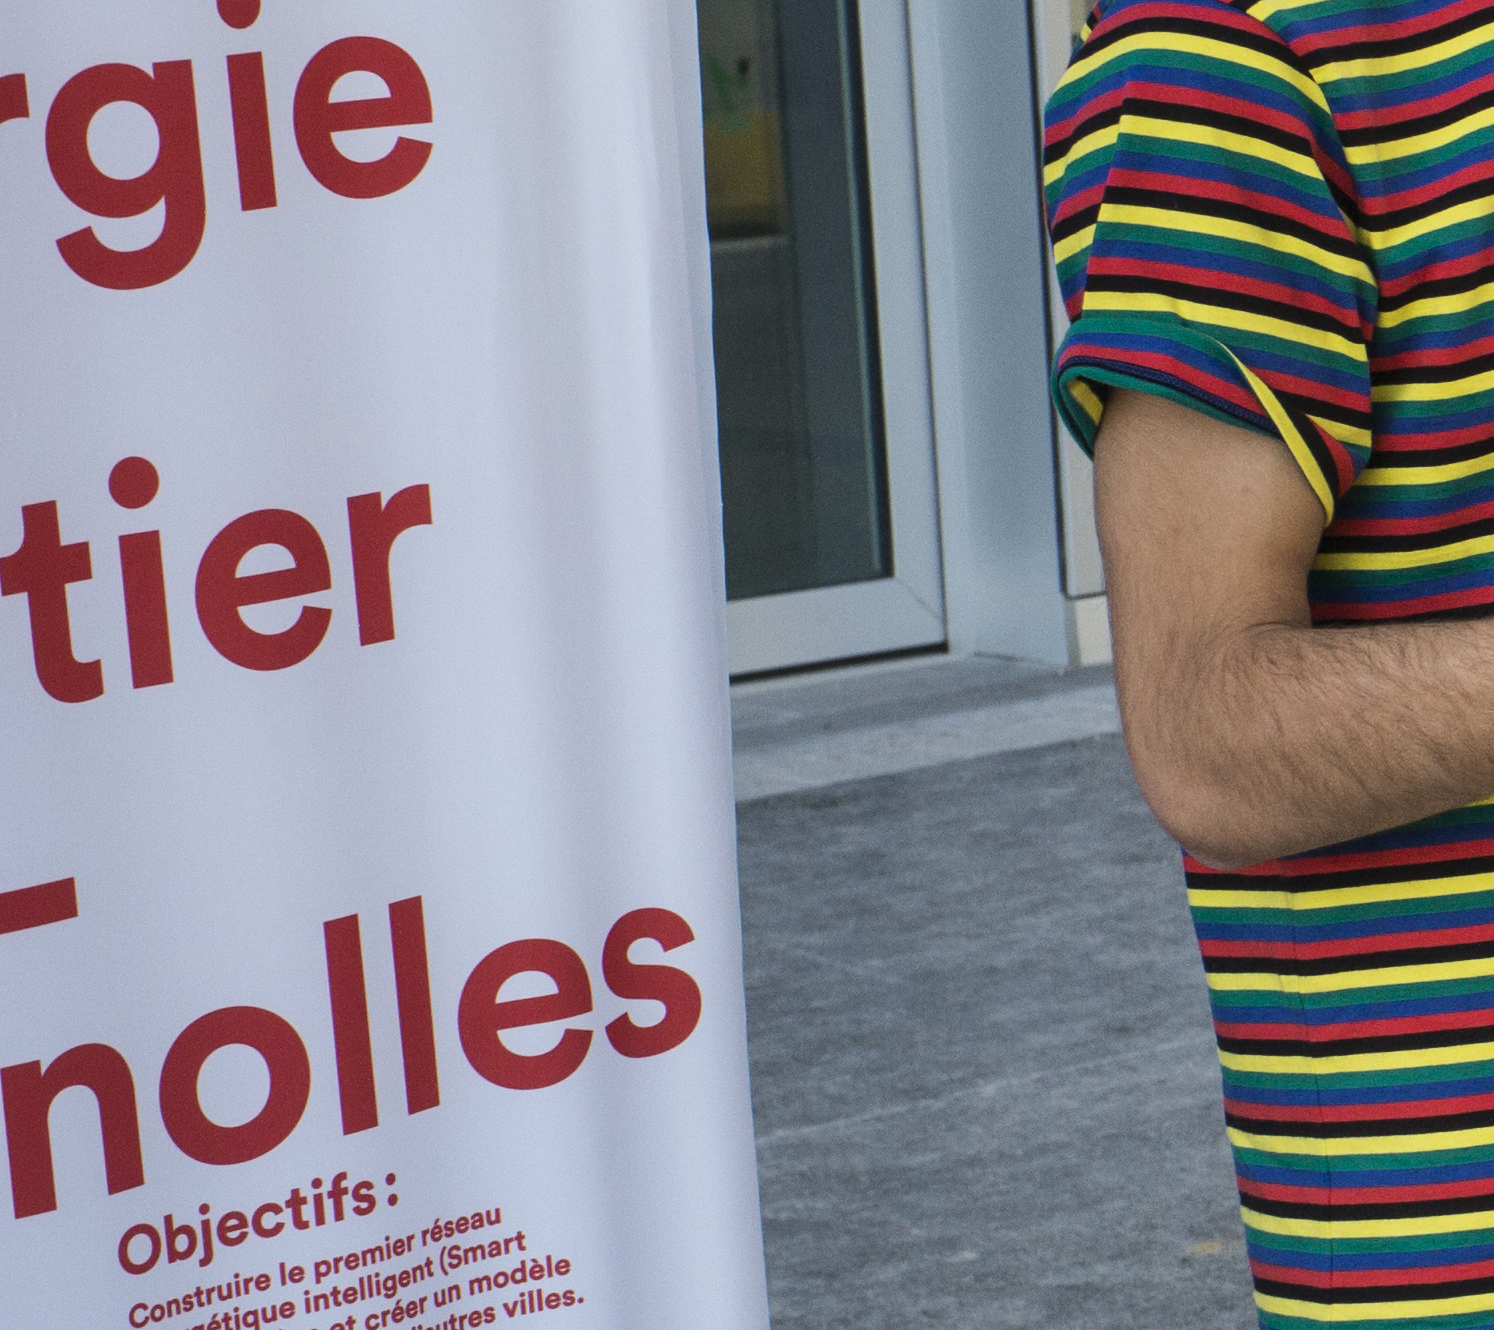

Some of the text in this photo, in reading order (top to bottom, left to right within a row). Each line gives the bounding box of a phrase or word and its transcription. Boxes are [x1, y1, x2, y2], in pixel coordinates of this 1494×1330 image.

[0, 456, 433, 703] tier
[0, 896, 701, 1219] nolles
[129, 1208, 501, 1329] Construire le premier réseau
[303, 1257, 434, 1314] intelligent
[439, 1231, 526, 1276] (Smart
[365, 1296, 427, 1330] créer
[433, 1284, 461, 1308] un
[469, 1255, 571, 1296] modèle
[502, 1289, 584, 1318] villes.
